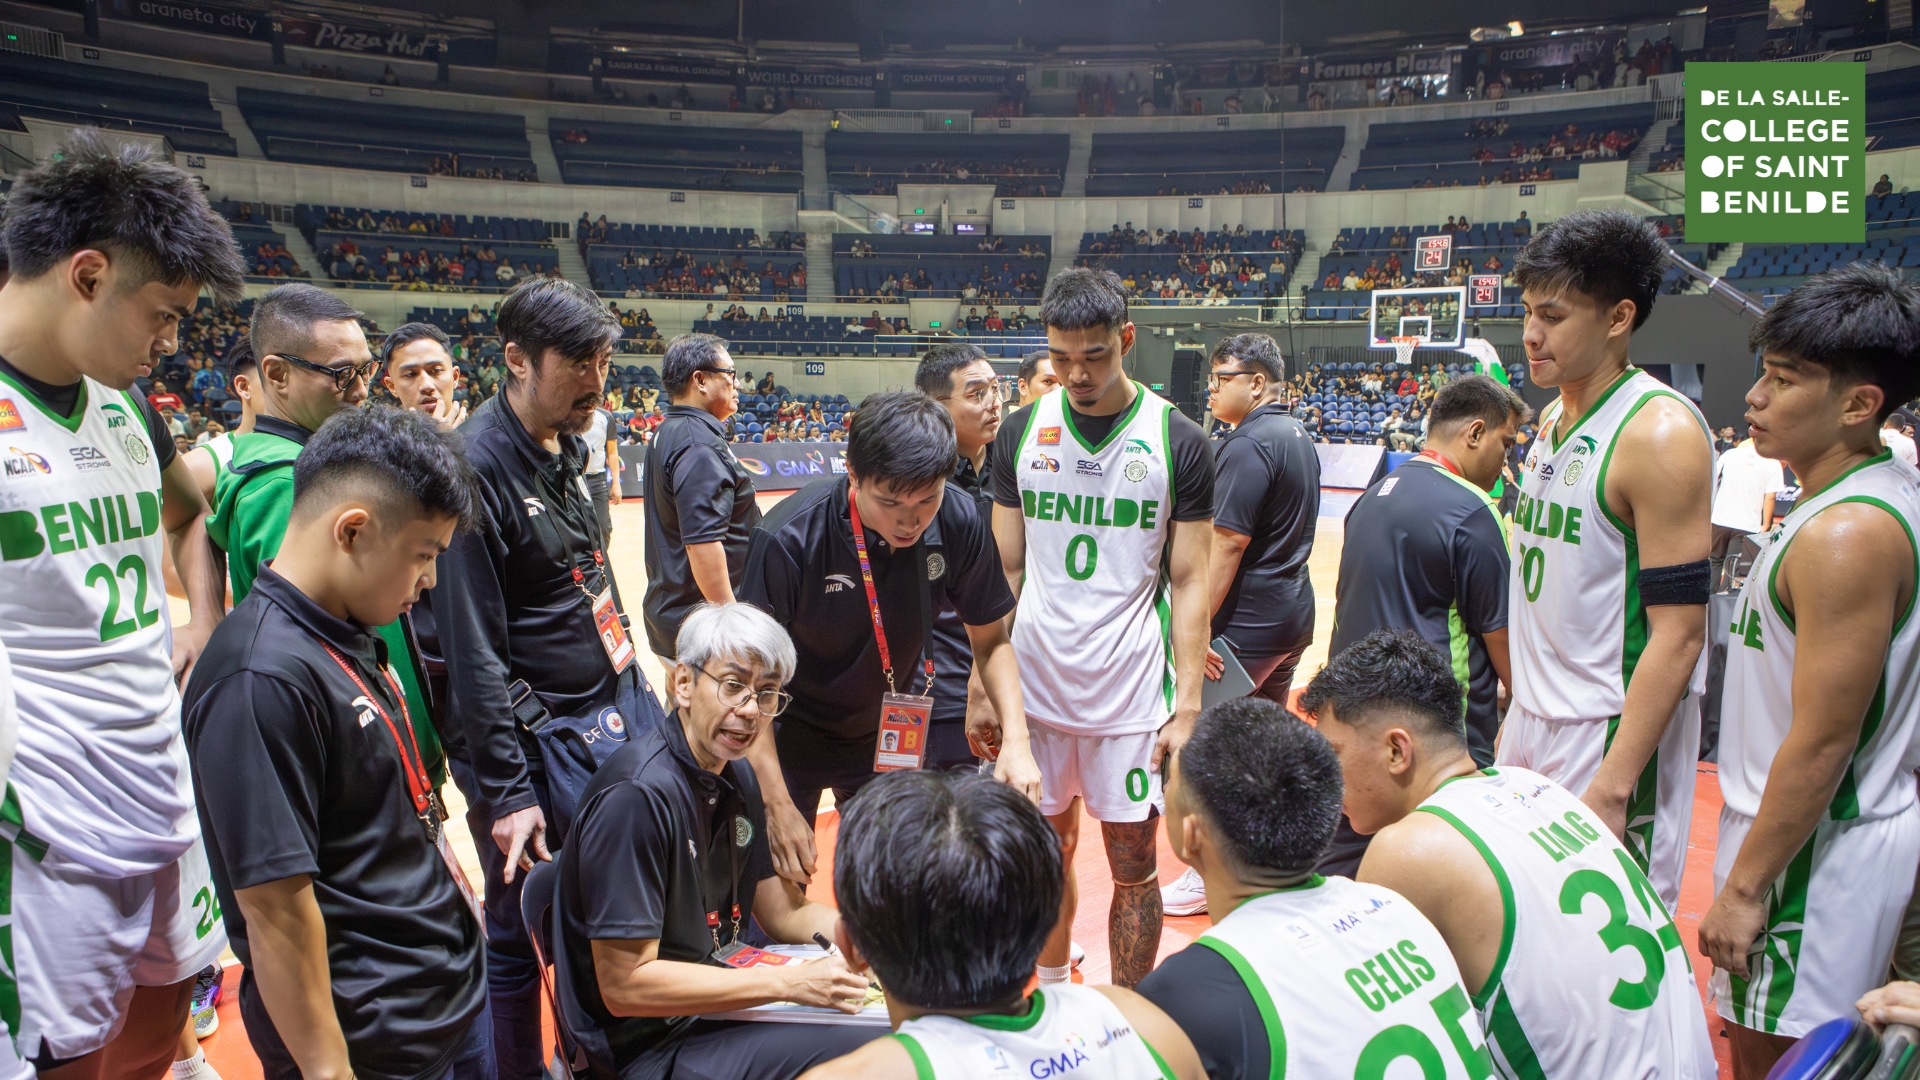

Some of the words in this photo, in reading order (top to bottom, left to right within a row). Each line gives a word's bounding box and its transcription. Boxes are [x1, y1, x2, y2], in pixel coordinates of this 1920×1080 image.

[139, 2, 214, 24] araneta
[220, 13, 258, 34] city
[315, 22, 383, 50] Pizza
[386, 31, 437, 57] Hut
[1500, 43, 1564, 61] araneta
[1570, 38, 1606, 55] city
[1854, 53, 1870, 61] 413
[1314, 61, 1392, 79] Farmers
[1395, 53, 1450, 73] Plaza
[748, 71, 800, 84] WORLD
[803, 74, 873, 87] KITCHENS
[902, 74, 954, 83] QUANTUM
[957, 74, 1006, 83] SKYVIEW
[1520, 186, 1535, 195] 211
[1189, 199, 1202, 207] 210
[1426, 251, 1441, 265] 24
[1476, 289, 1491, 302] 24
[787, 306, 803, 315] 109
[806, 363, 824, 374] 109
[1125, 445, 1142, 454] ANTA
[4, 458, 36, 476] NCAA
[76, 461, 112, 470] STRONG
[776, 460, 824, 477] GMA
[1031, 460, 1048, 470] NCAA
[1076, 460, 1103, 471] SGA
[1021, 489, 1160, 530] BENILDE
[0, 488, 163, 561] BENILD
[1065, 533, 1098, 581] 0
[825, 583, 843, 594] ANTA
[85, 554, 159, 643] 22
[904, 730, 918, 749] B
[1125, 767, 1149, 802] 0
[1333, 914, 1362, 934] MA
[1559, 848, 1692, 1011] 34
[1344, 939, 1436, 1013] CELIS
[1030, 1048, 1090, 1079] GMA
